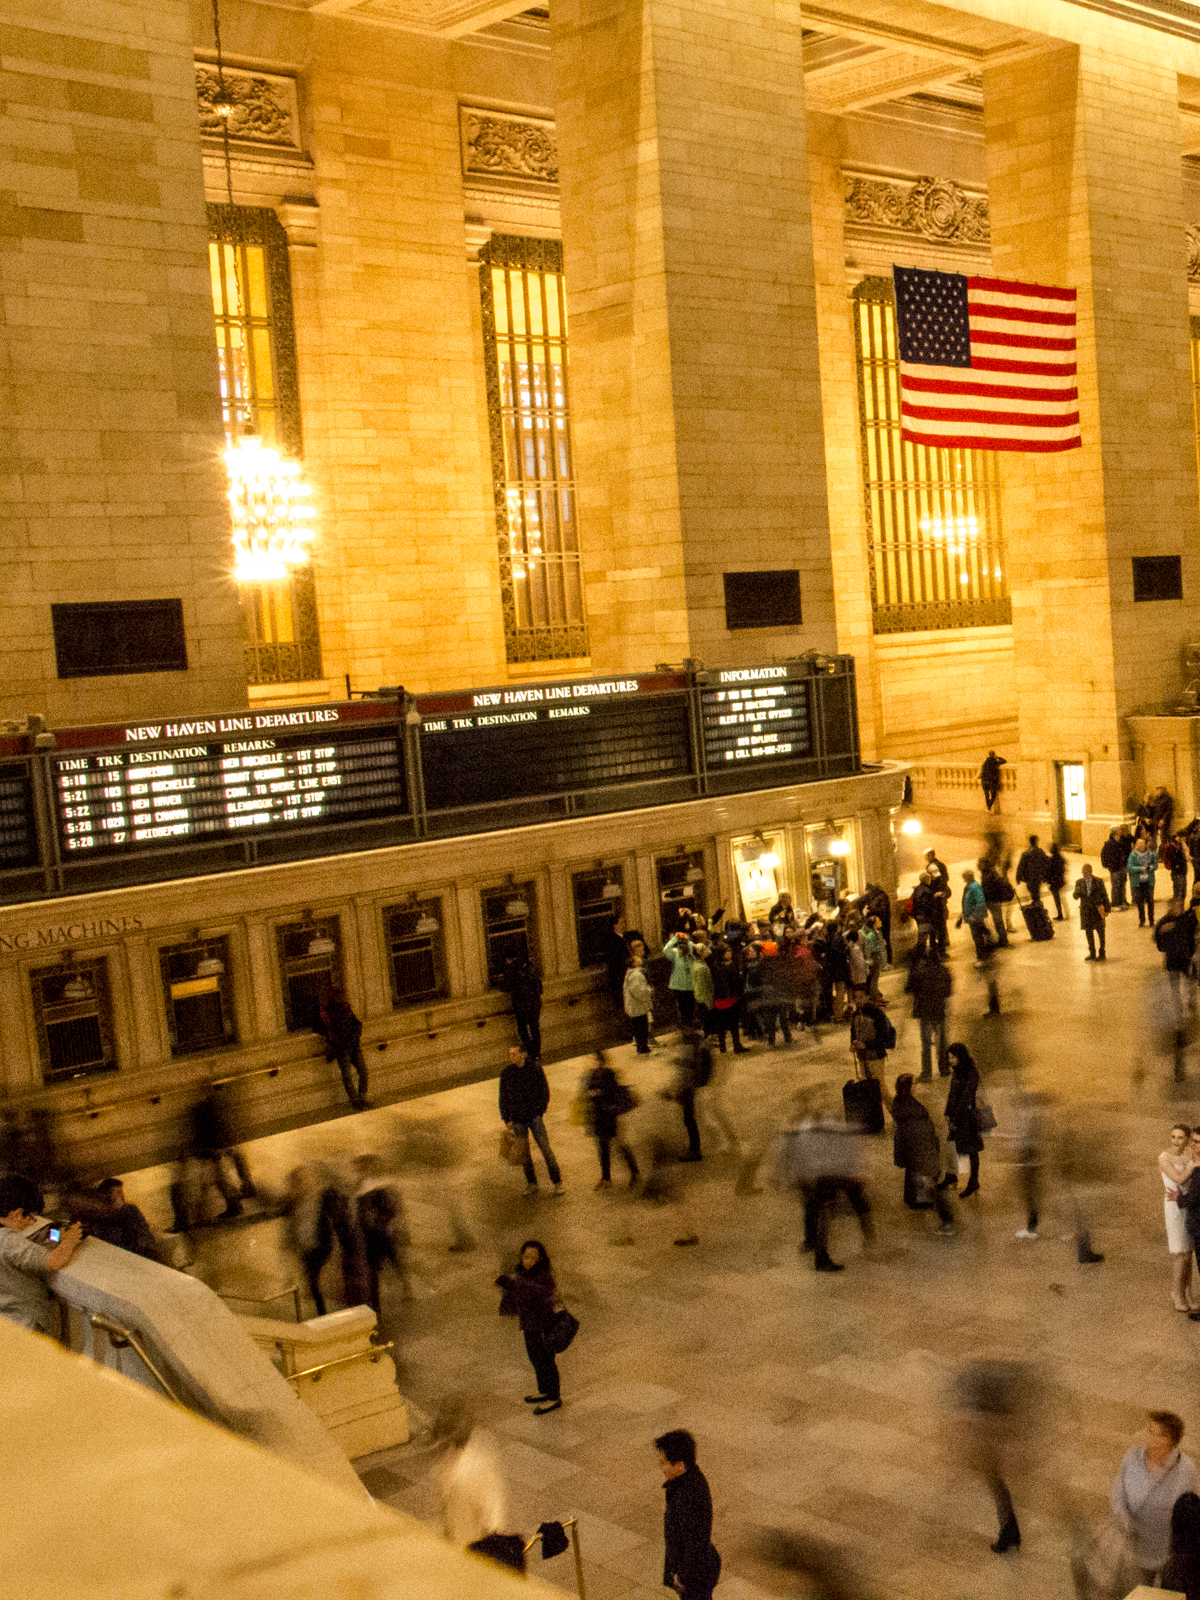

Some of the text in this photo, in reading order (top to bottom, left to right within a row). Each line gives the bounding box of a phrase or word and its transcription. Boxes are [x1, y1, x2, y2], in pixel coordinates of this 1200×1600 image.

[720, 666, 787, 682] INFORMATION
[473, 680, 639, 707] NEW HAVEN LINE DEPARTURES
[125, 709, 339, 741] NEW HAVEN LINE DEPARTURES
[424, 706, 590, 732] TIME TRK DESTINATION REMARKS
[746, 711, 767, 722] POLICE
[59, 739, 276, 771] TIME TRK DESTINATION REMARKS
[107, 771, 120, 782] 15
[296, 749, 311, 761] 1ST
[314, 747, 335, 759] STOP
[63, 790, 87, 803] 5:21
[298, 763, 313, 775] 1ST
[315, 761, 336, 773] STOP
[65, 806, 90, 818] 5:22
[111, 801, 124, 813] 19
[255, 784, 267, 795] TO
[298, 777, 319, 789] LINE
[67, 821, 92, 834] 5:26
[226, 798, 273, 813] GLENBROOK
[286, 794, 301, 805] 1ST
[304, 791, 325, 803] STOP
[68, 836, 94, 849] 5:28
[113, 831, 126, 843] 27
[135, 823, 190, 840] BRIDGEPORT
[283, 808, 298, 820] 1ST
[300, 805, 322, 818] STOP
[37, 914, 143, 945] MACHINES
